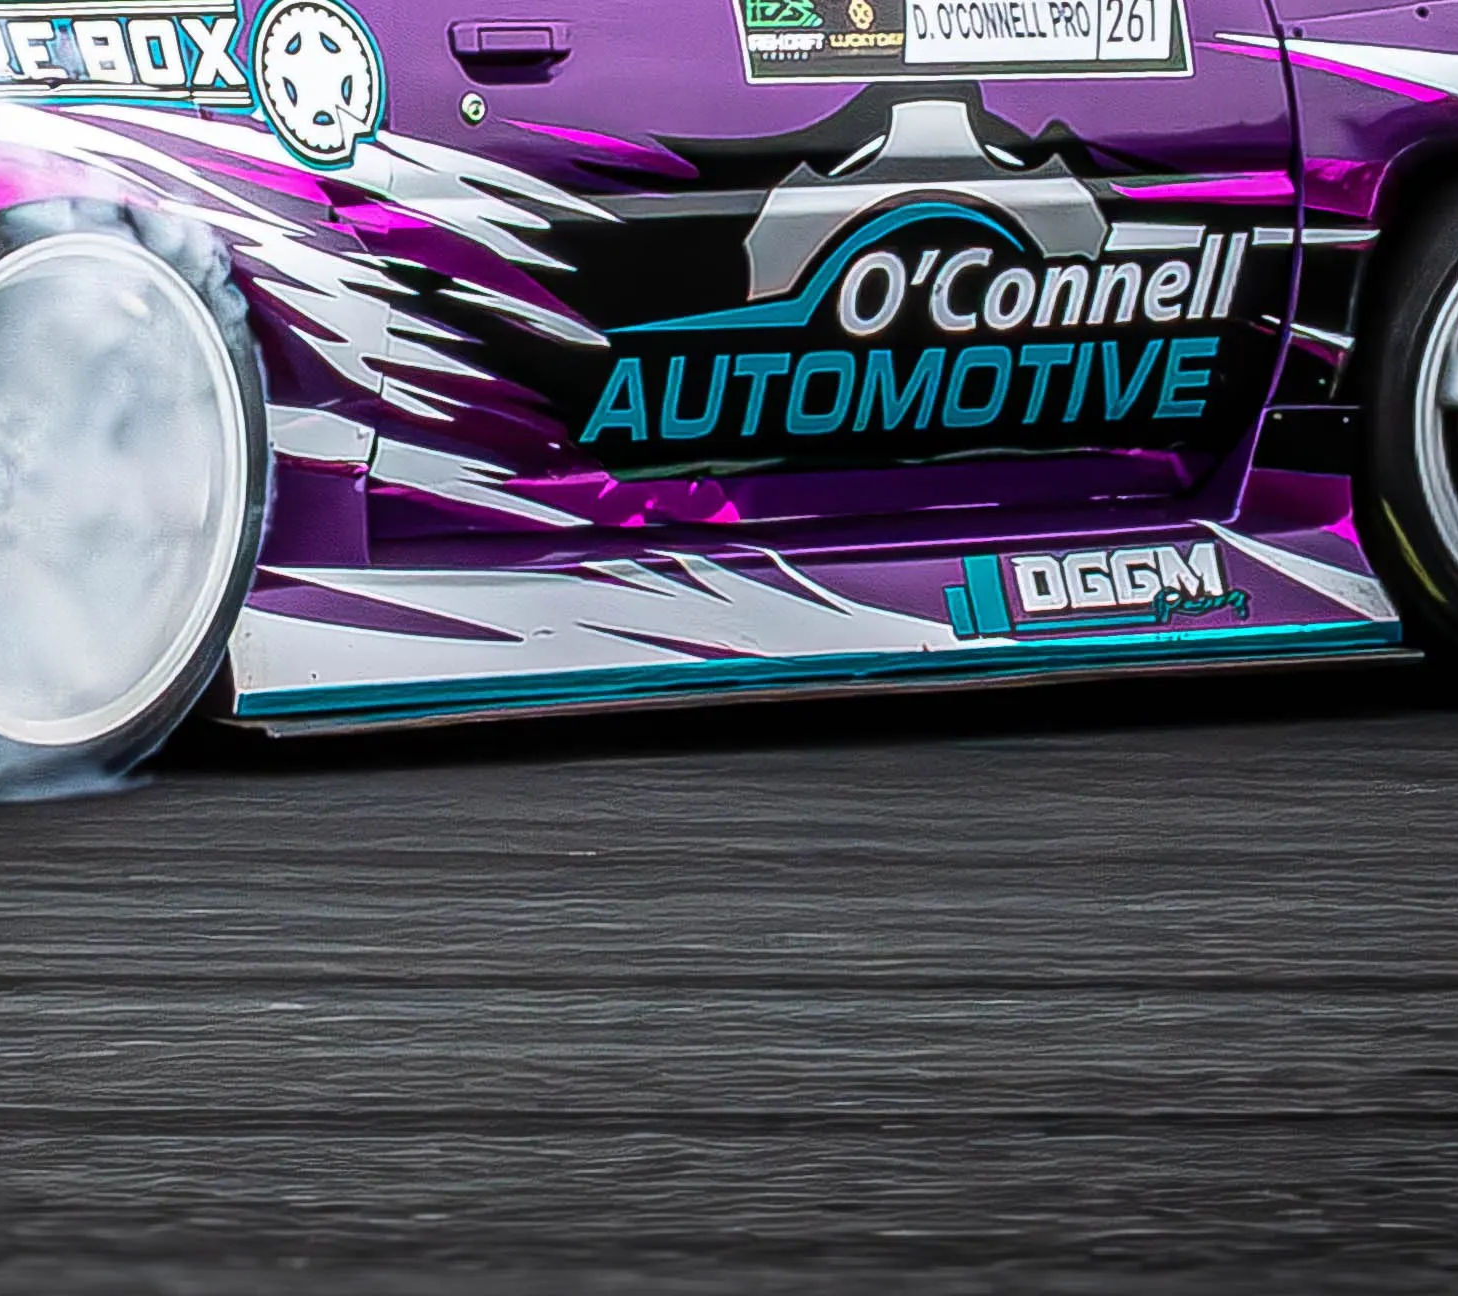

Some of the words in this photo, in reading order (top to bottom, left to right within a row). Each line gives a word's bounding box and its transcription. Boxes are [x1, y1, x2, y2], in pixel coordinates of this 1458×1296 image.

[80, 17, 249, 87] BOX
[912, 3, 936, 40] D.
[937, 2, 1047, 40] O'CONNELL
[1049, 1, 1090, 38] PRO
[837, 234, 1246, 335] O'Connell
[579, 337, 1220, 443] AUTOMOTIVE
[1011, 542, 1223, 611] DGGM
